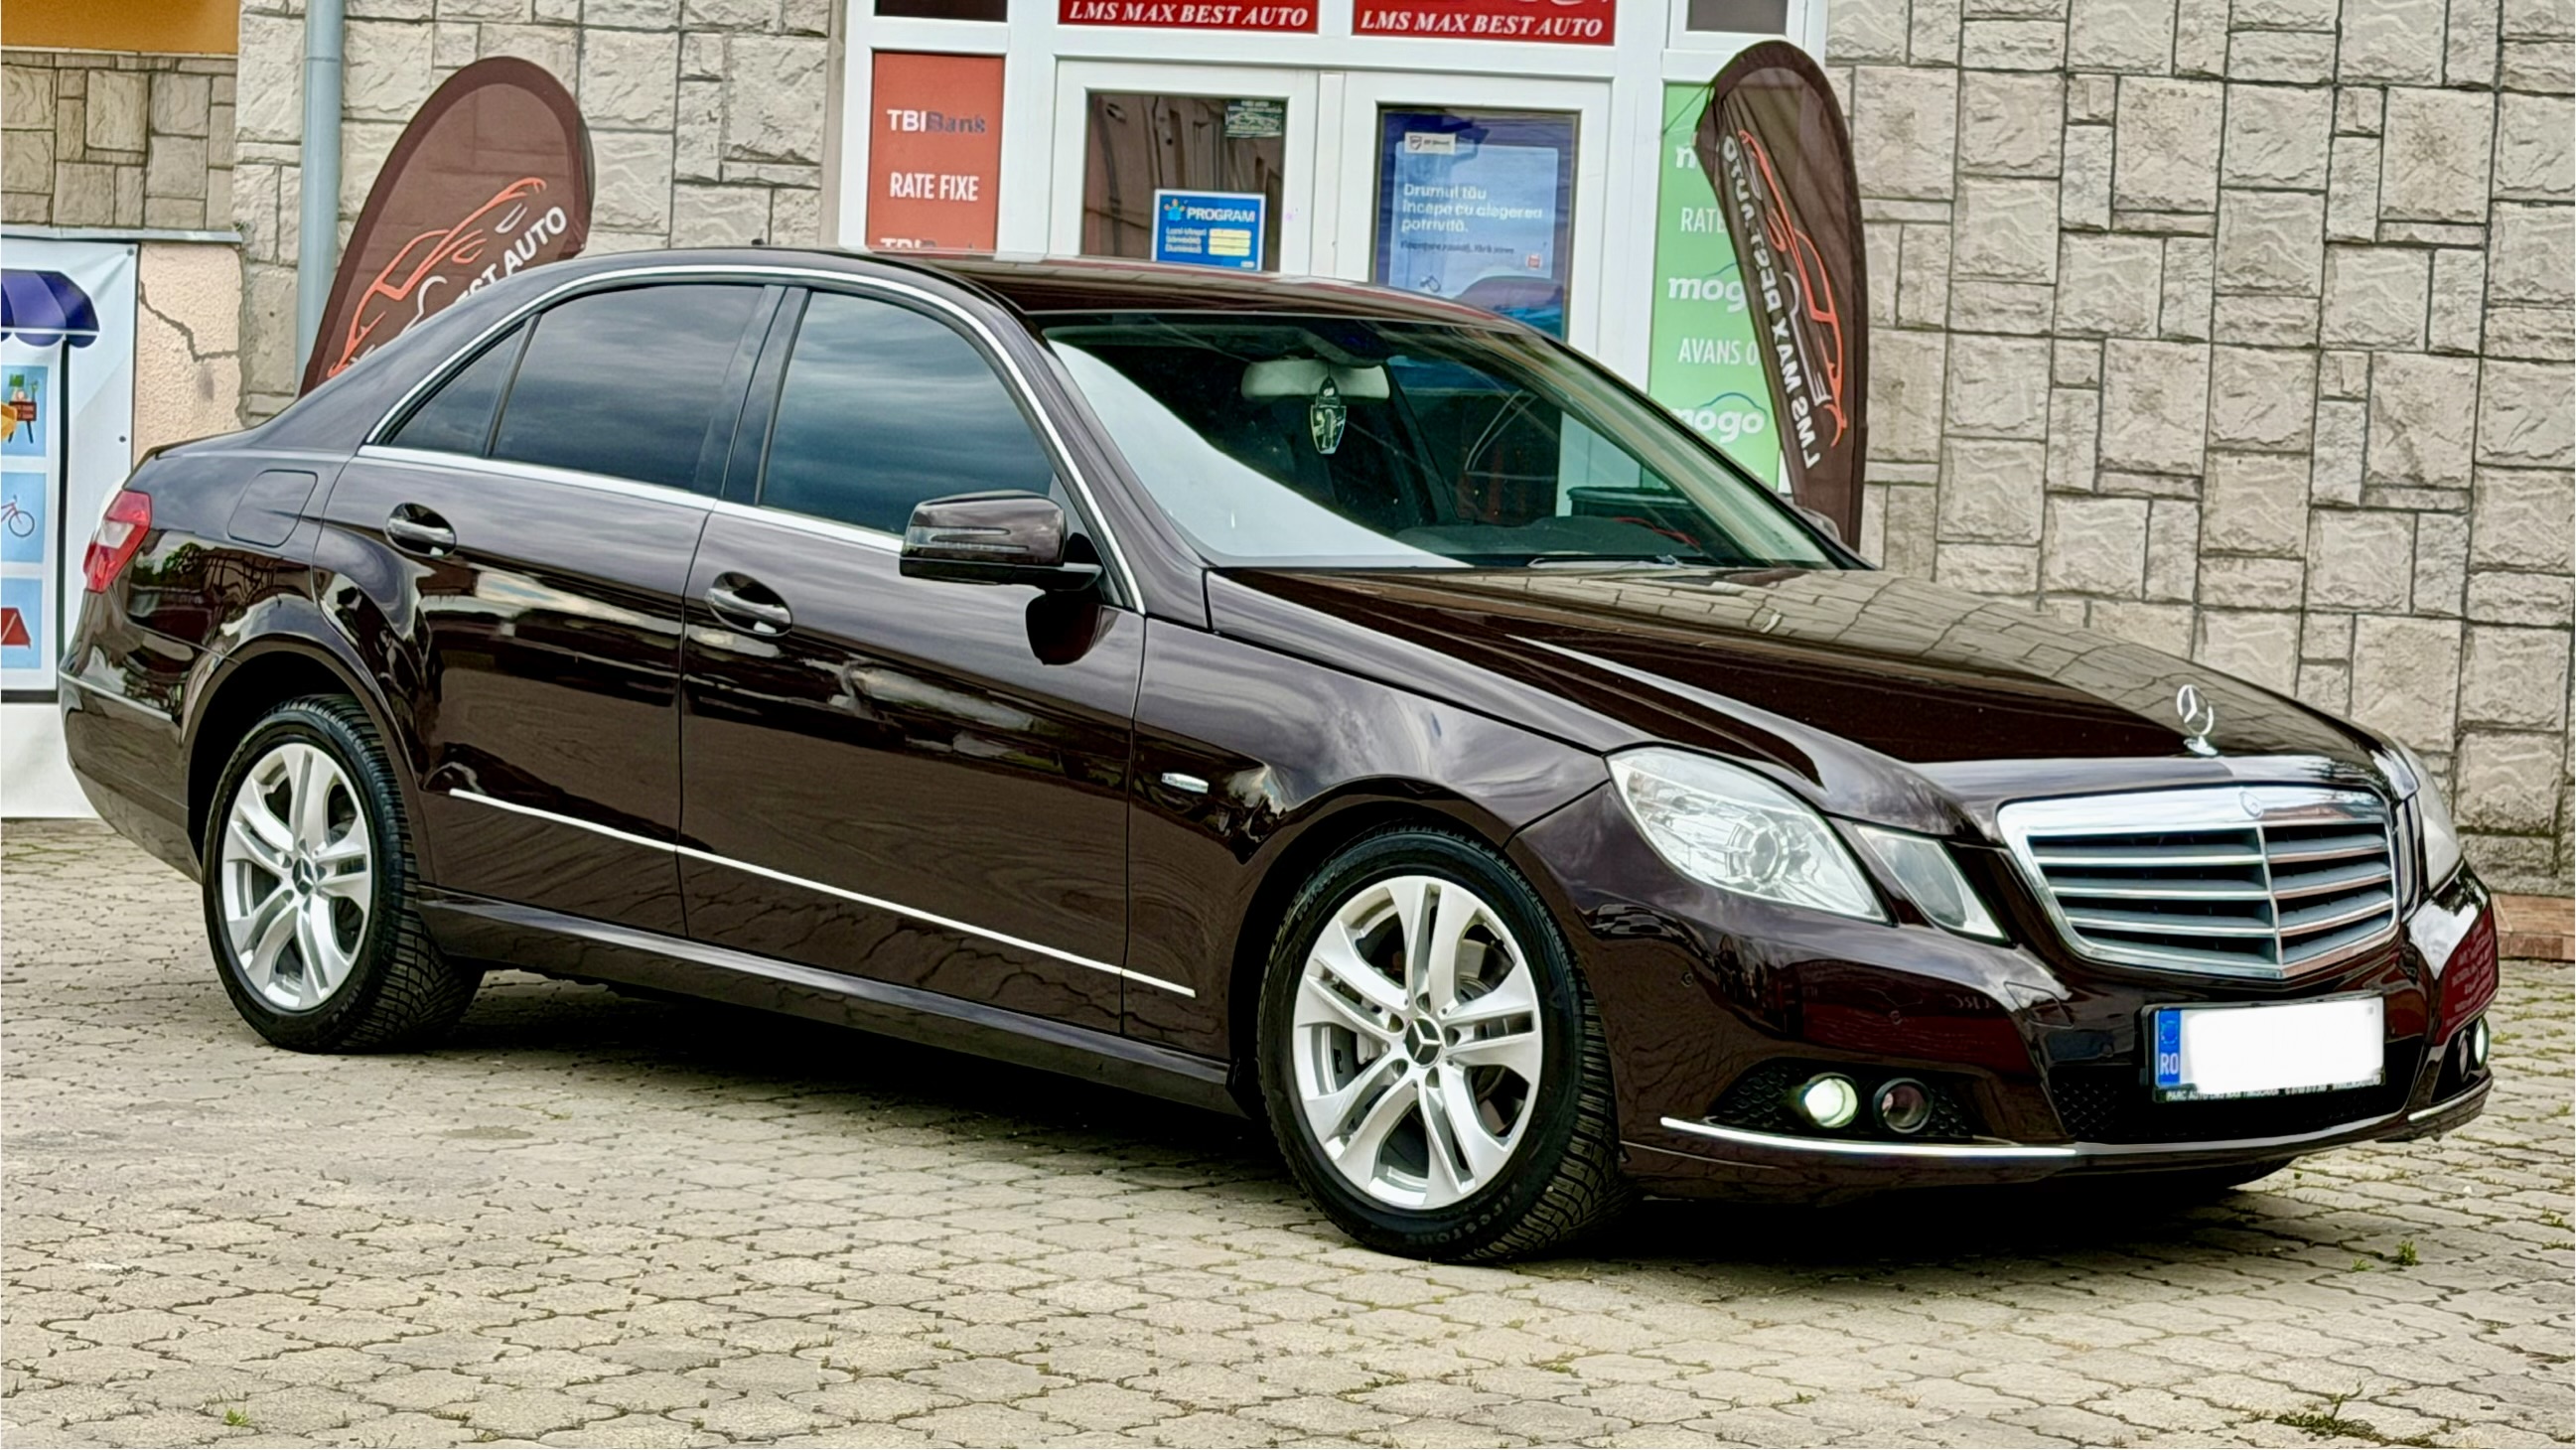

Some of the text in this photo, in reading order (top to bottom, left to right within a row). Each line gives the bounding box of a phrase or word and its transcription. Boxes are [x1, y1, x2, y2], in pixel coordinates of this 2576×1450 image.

[1069, 1, 1308, 27] LMS MAX BEST AUTO
[1360, 10, 1604, 38] LMS MAX BEST AUTO
[890, 172, 979, 202] RATE FIXE
[1186, 207, 1256, 223] PROGRAM
[503, 207, 567, 277] AUTO
[1667, 276, 1746, 313] mog
[1678, 338, 1742, 365] AVANS
[2159, 1053, 2180, 1076] RO
